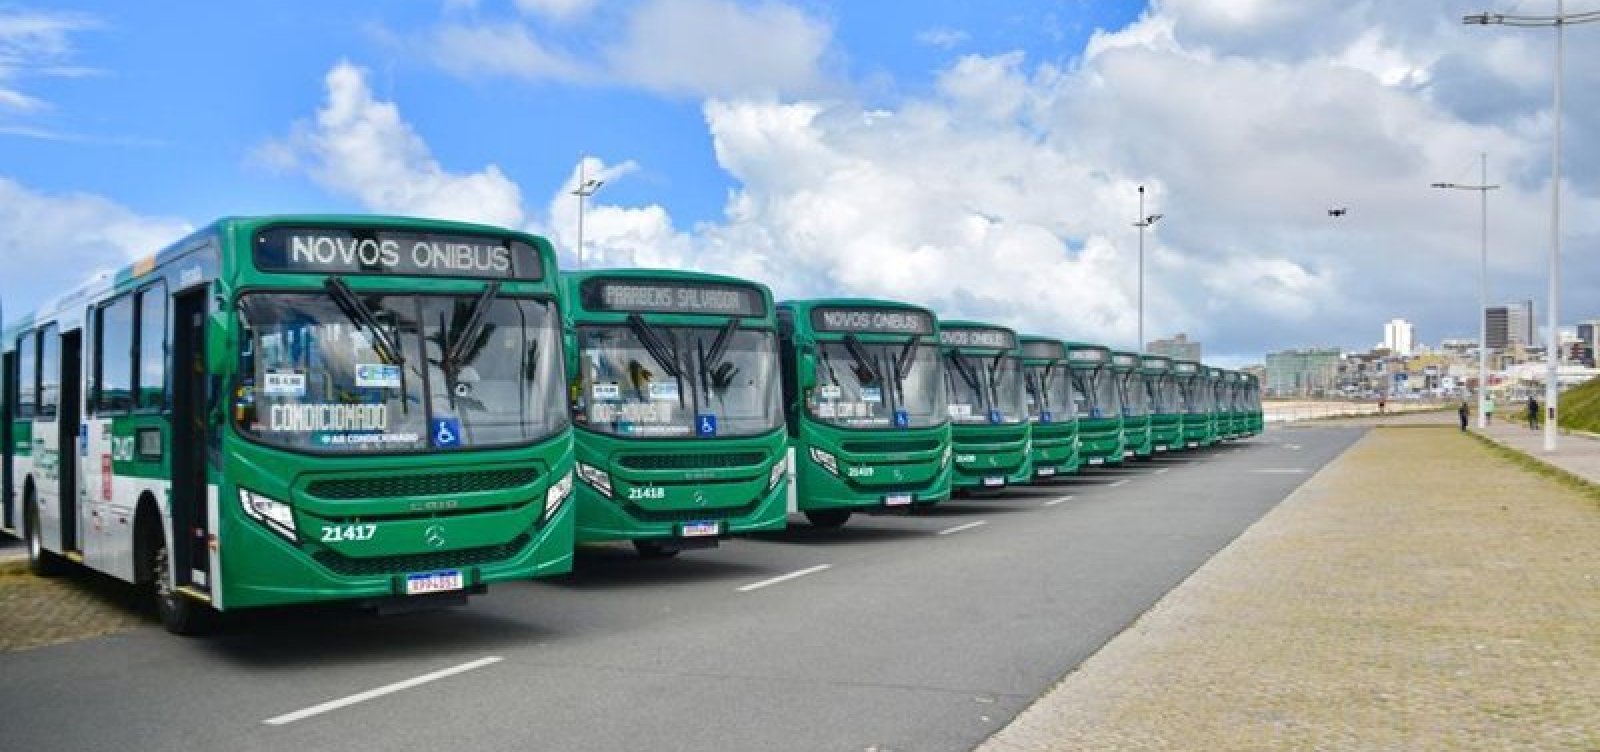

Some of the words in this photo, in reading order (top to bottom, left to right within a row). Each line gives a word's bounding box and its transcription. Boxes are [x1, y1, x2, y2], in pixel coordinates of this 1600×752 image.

[292, 236, 400, 267] NOVOS
[412, 242, 510, 271] ONIBUS
[604, 284, 672, 307] PARABENS
[823, 311, 870, 328] NOVOS
[873, 312, 917, 330] ONIBUS
[271, 403, 388, 431] CONDICIONADO
[628, 487, 666, 499] 21418
[321, 523, 377, 542] 21417
